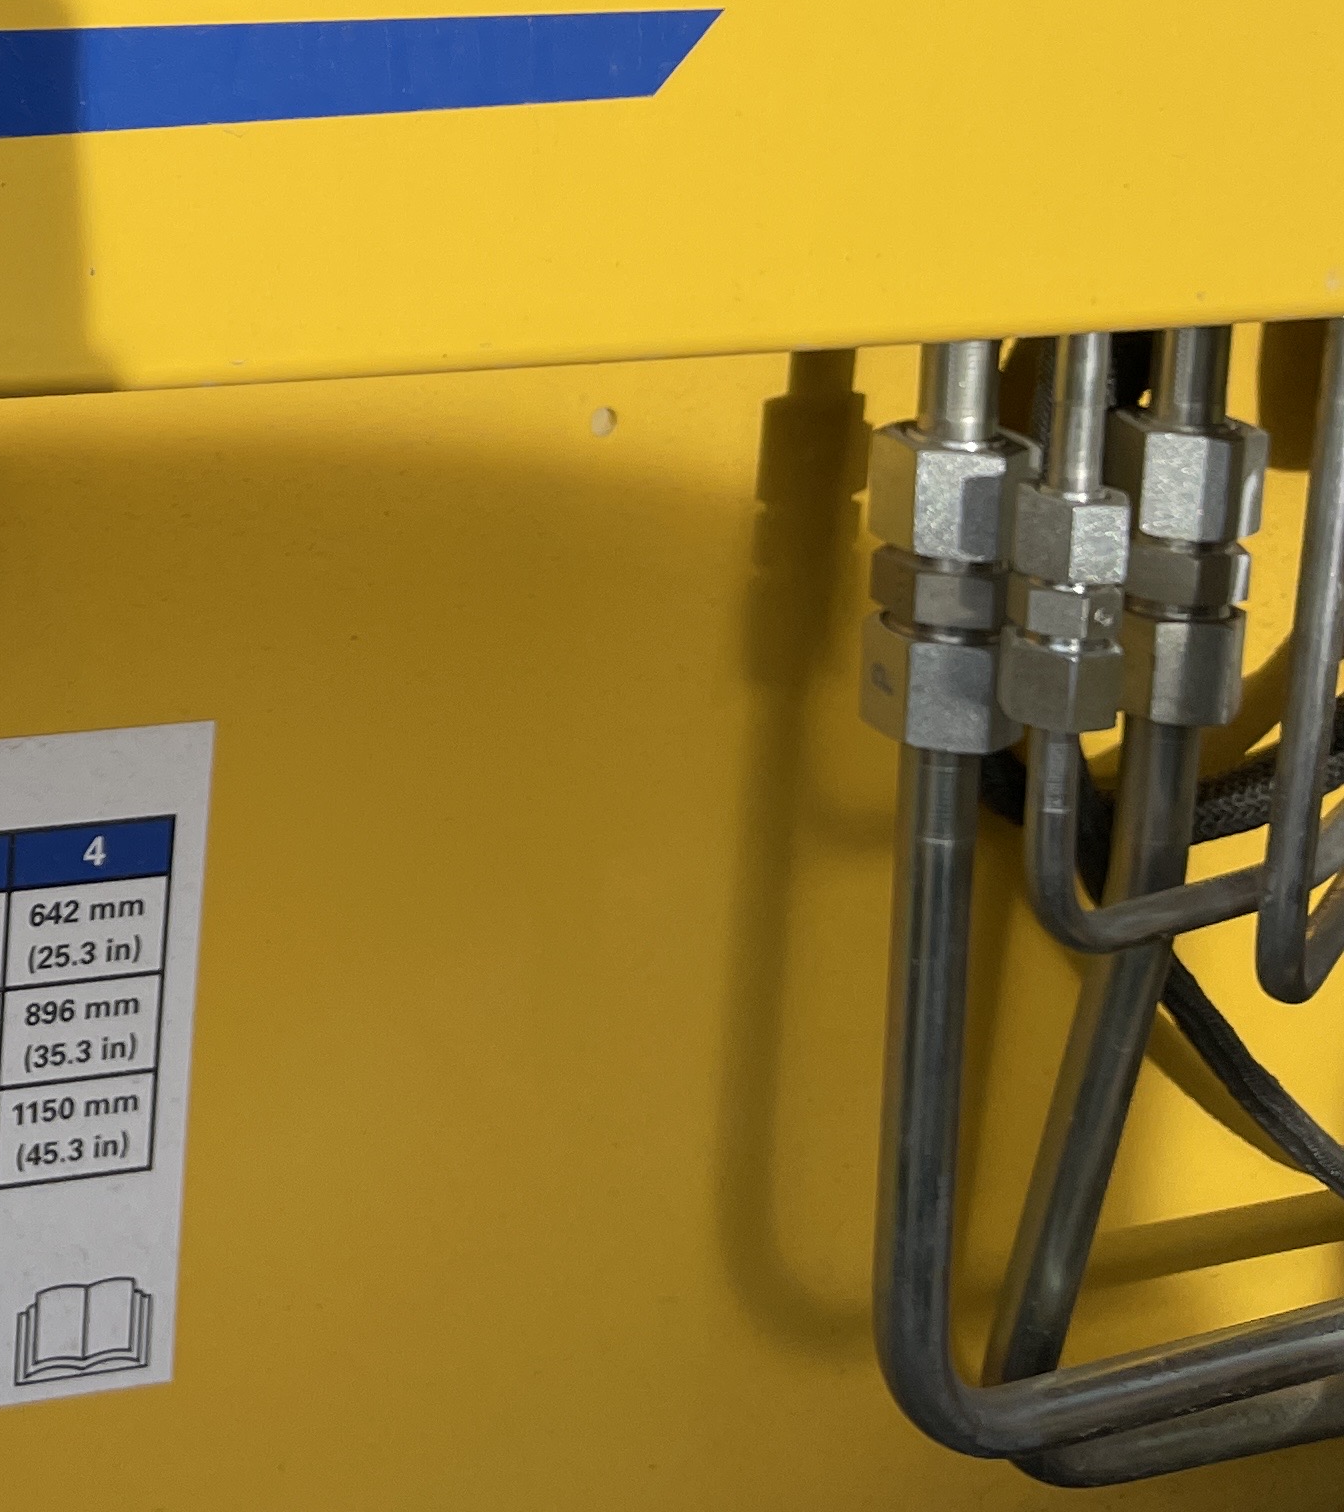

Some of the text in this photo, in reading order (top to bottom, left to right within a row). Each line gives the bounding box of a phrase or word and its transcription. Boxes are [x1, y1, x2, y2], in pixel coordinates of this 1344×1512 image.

[84, 836, 106, 865] 4
[29, 899, 145, 927] 642 mm
[28, 934, 142, 974] (25.3 in)
[24, 998, 140, 1026] 896 mm
[24, 1032, 138, 1073] (35.3 in)
[12, 1094, 140, 1126] 1150 mm
[16, 1130, 130, 1172] (45.3 in)
